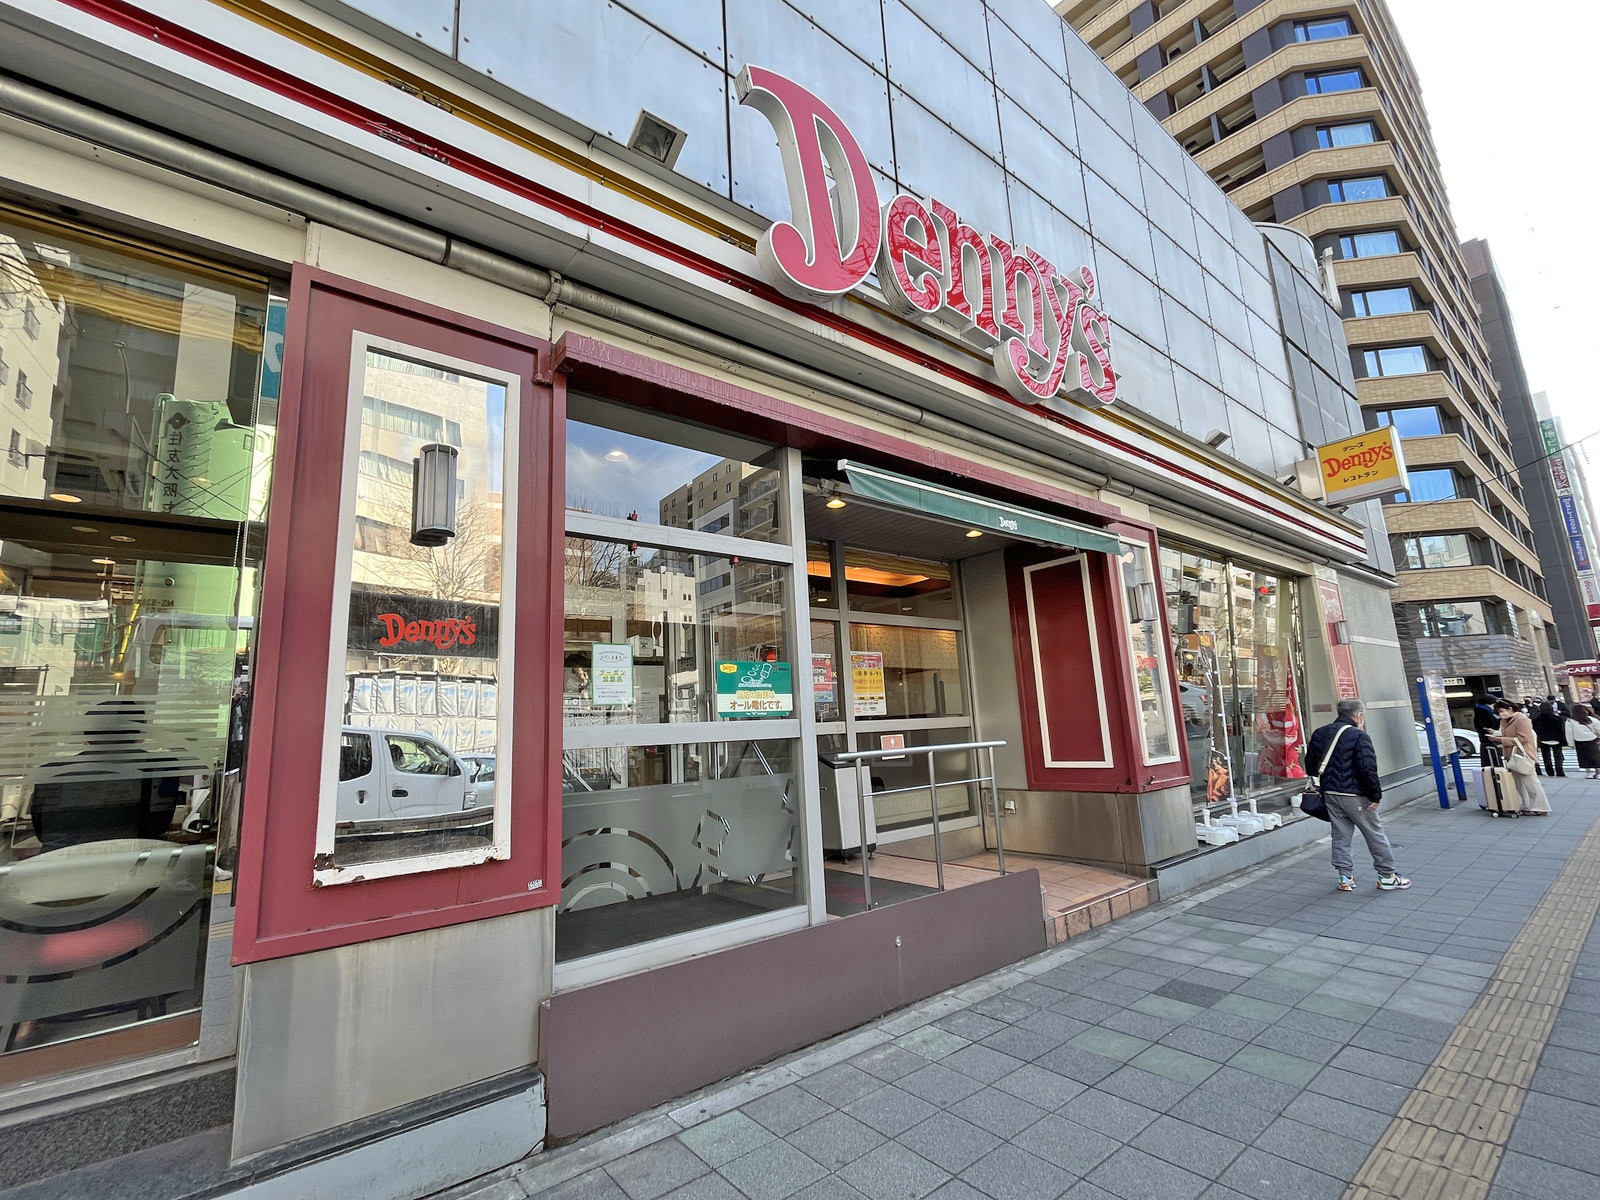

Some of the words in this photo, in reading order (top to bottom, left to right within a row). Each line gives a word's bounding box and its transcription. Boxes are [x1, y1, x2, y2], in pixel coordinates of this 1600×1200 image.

[736, 63, 1118, 404] Denny's
[1322, 441, 1394, 478] Denny's
[1343, 470, 1379, 483] レストラン
[377, 613, 477, 650] Denny's
